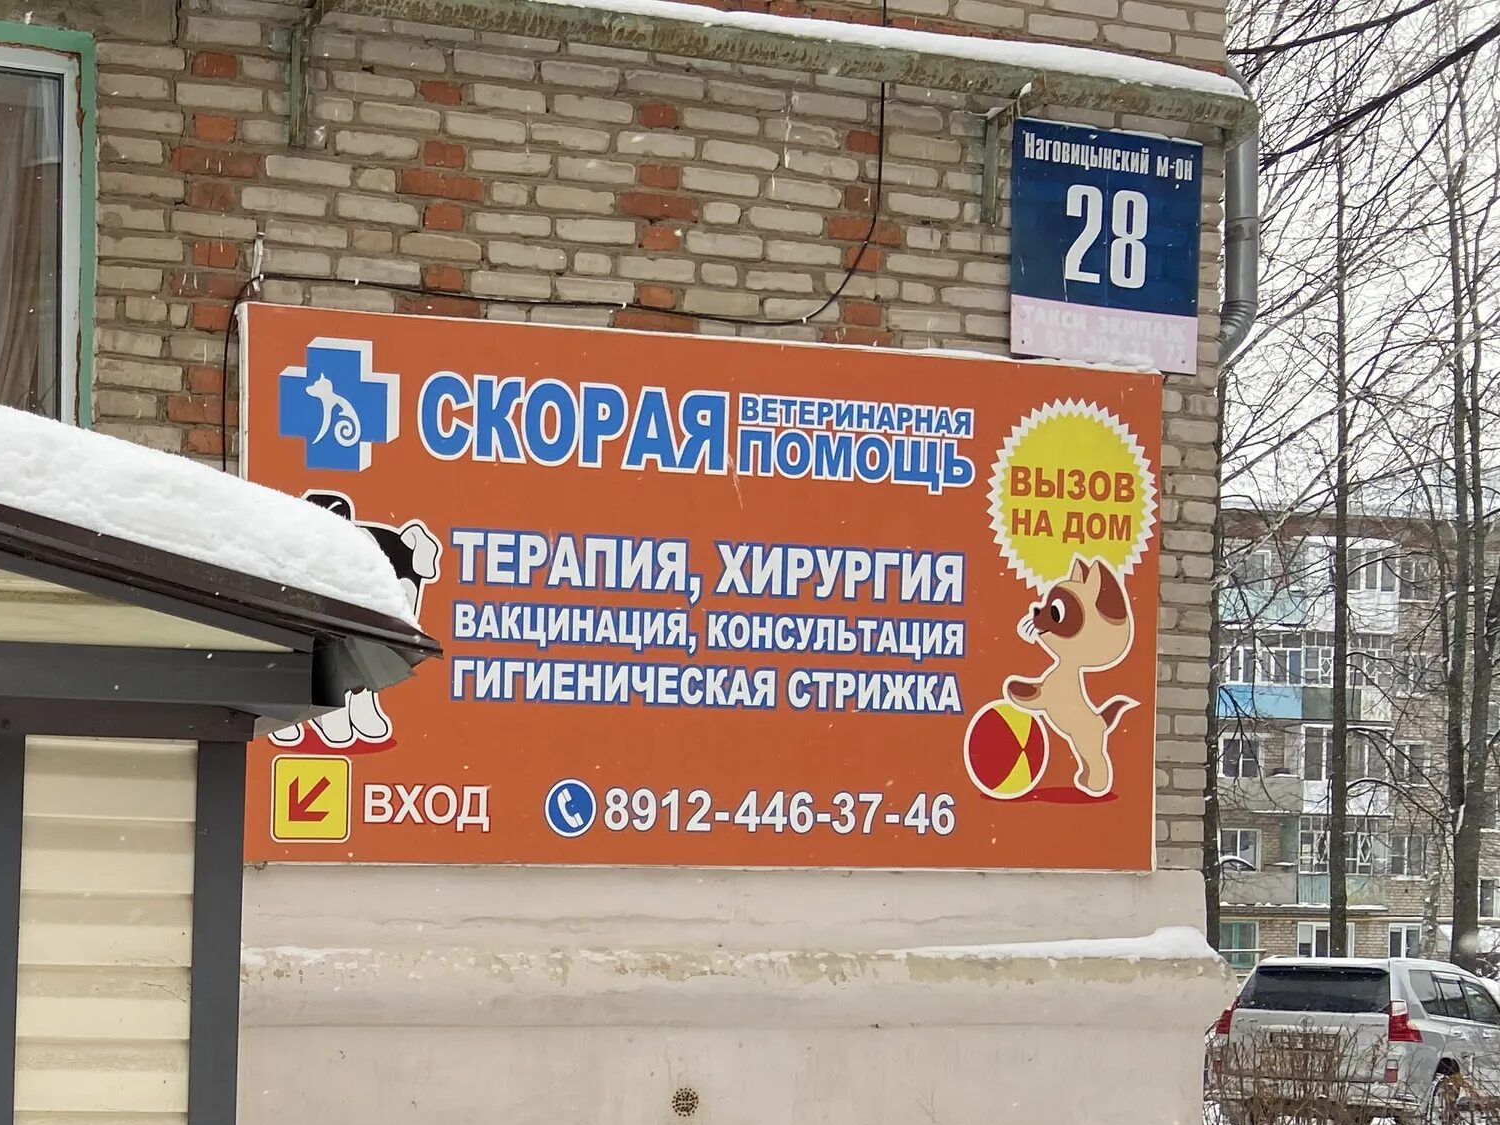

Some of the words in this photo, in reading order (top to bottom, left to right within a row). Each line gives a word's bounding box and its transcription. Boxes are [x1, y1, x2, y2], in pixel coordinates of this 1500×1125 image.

[1023, 132, 1150, 175] Наговицынский
[1065, 184, 1149, 289] 28
[1021, 305, 1088, 331] ТАКСИ
[418, 370, 731, 475] СКОРАЯ
[738, 394, 975, 439] ВЕТЕРИНАРНАЯ
[737, 425, 976, 495] ПОМОЩЬ
[1009, 465, 1136, 504] ВЫЗОВ
[1011, 507, 1054, 537] НА
[1061, 510, 1132, 545] ДОМ
[452, 529, 702, 605] ТЕРАПИЯ,
[715, 541, 965, 604] ХИРУРГИЯ
[454, 602, 698, 655] ВАКЦИНАЦИЯ,
[706, 611, 965, 661] КОНСУЛЬТАЦИЯ
[453, 659, 777, 708] ГИГИЕНИЧЕСКАЯ
[787, 670, 963, 713] СТРИЖКА
[363, 783, 491, 833] ВХОД
[603, 786, 957, 835] 8912-446-37-46
